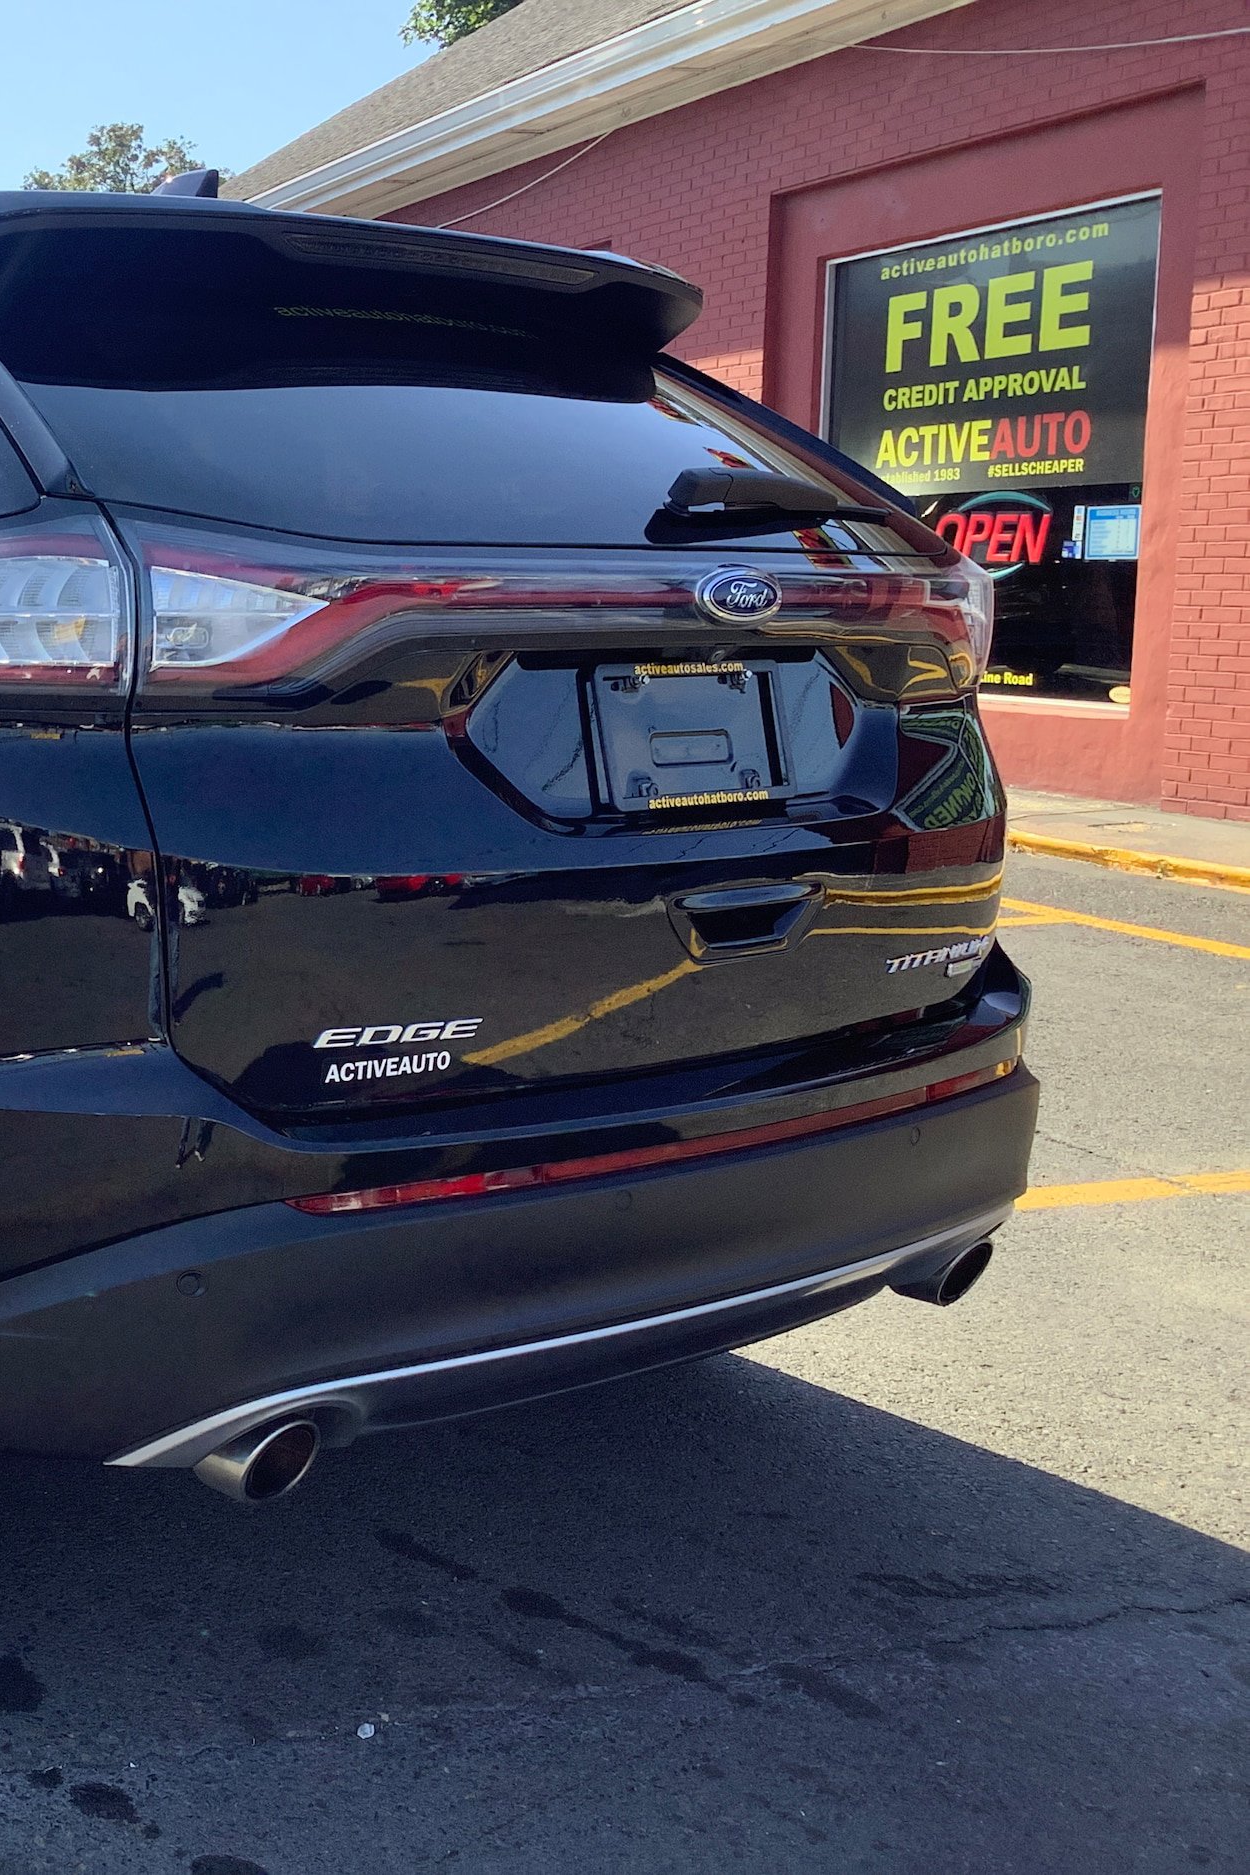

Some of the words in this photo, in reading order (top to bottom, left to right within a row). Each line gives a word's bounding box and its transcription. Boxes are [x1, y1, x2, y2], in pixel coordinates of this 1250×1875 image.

[880, 222, 1110, 281] activeautohatboro.com
[885, 260, 1093, 373] FREE
[883, 381, 959, 411] CREDIT
[962, 365, 1086, 403] APPROVAL
[875, 410, 1092, 469] ACTIVEAUTO
[880, 470, 931, 485] stablished
[933, 467, 961, 482] 1983
[987, 459, 1085, 478] #SELLSCHEAPER
[936, 513, 1051, 564] OPEN
[726, 581, 768, 609] Ford
[634, 662, 744, 675] activeautosales.com
[1003, 671, 1034, 686] Road
[649, 789, 769, 810] activeautohatboro.com
[313, 1017, 484, 1049] EDGE
[325, 1051, 451, 1084] ACTIVEAUTO
